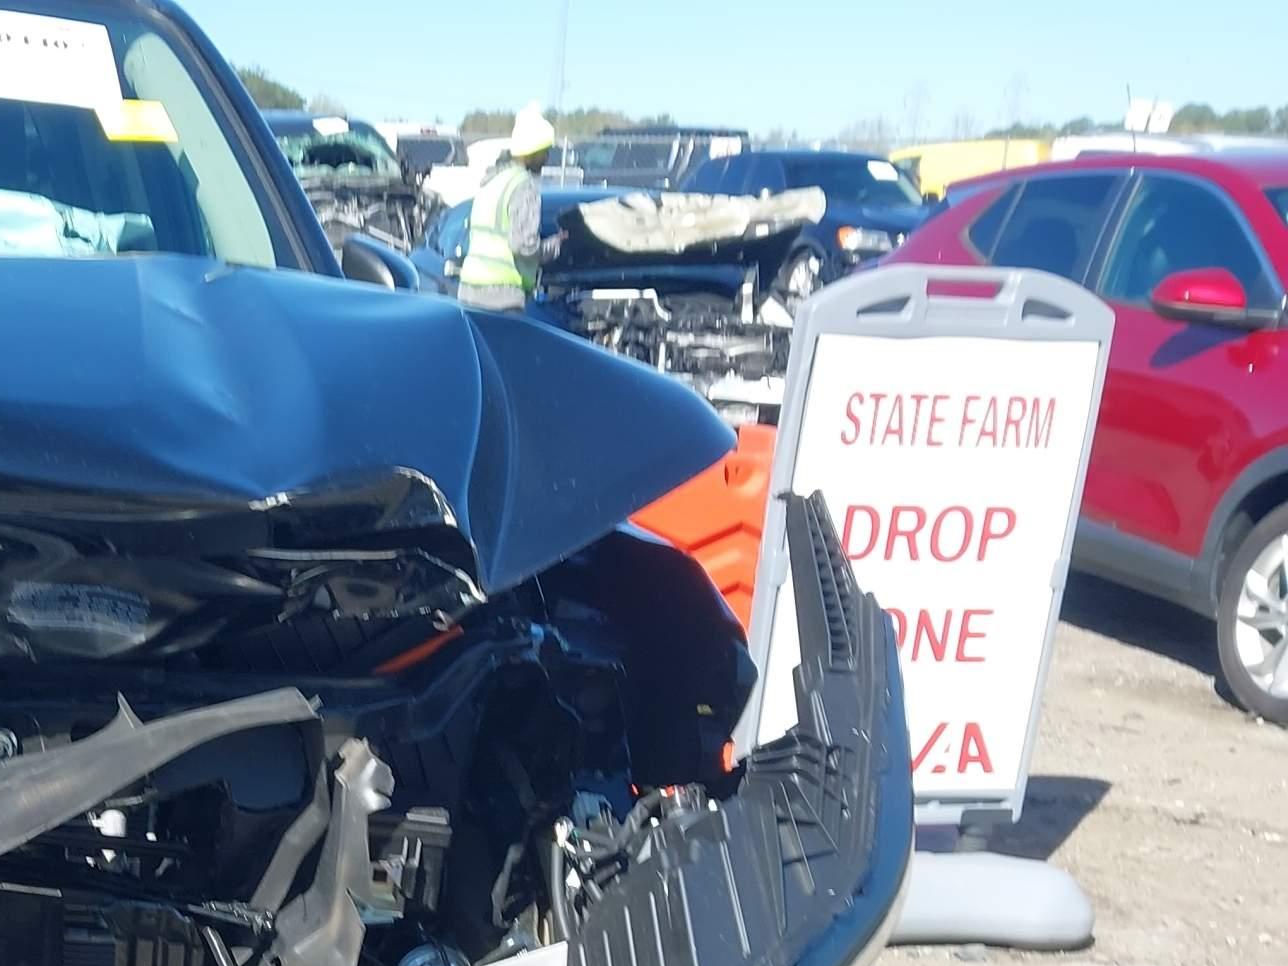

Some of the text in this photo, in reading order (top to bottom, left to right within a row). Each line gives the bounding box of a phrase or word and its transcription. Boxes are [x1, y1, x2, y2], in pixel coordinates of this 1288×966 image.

[839, 392, 1056, 448] STATE FARM
[842, 505, 1017, 562] DROP
